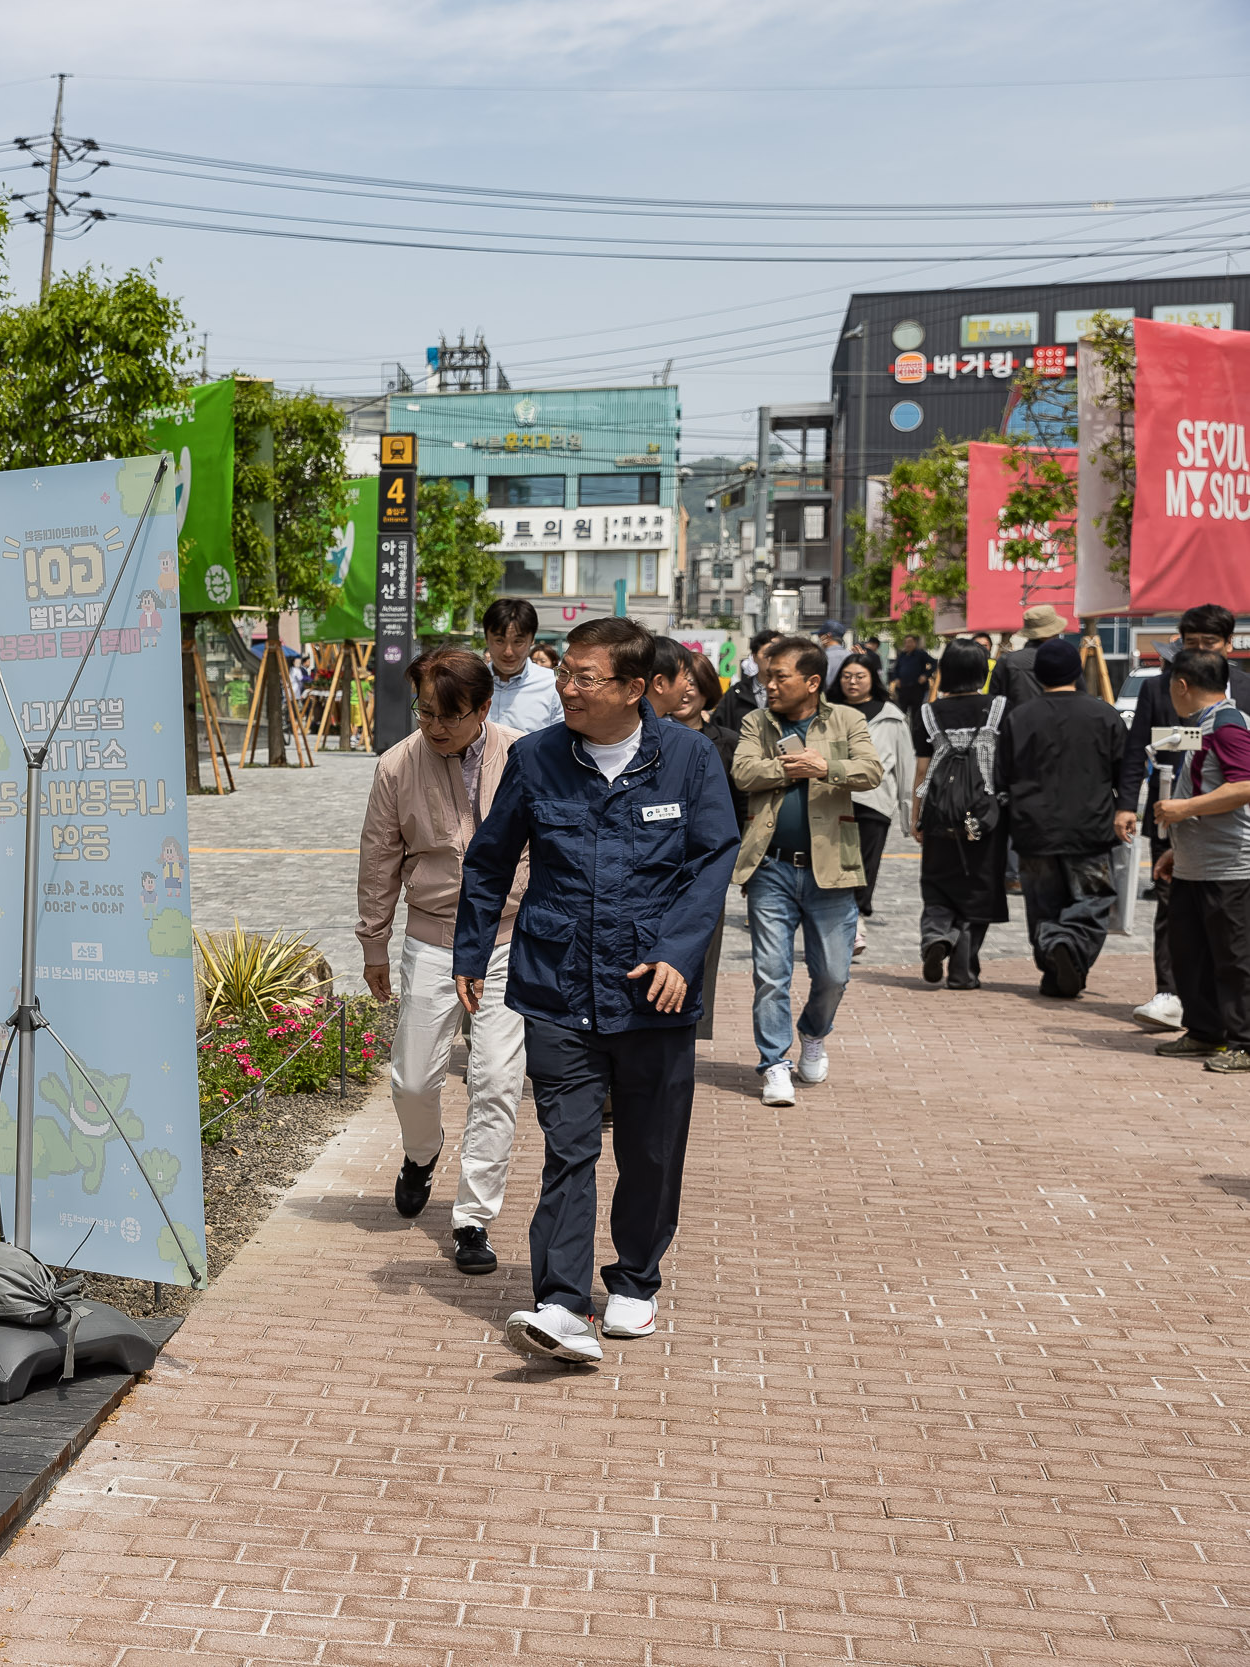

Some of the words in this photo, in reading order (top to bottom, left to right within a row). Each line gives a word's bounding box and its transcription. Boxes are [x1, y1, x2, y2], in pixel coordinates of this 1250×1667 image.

[933, 351, 1013, 379] 버거킹
[387, 477, 406, 504] 4
[381, 540, 397, 600] 아차산
